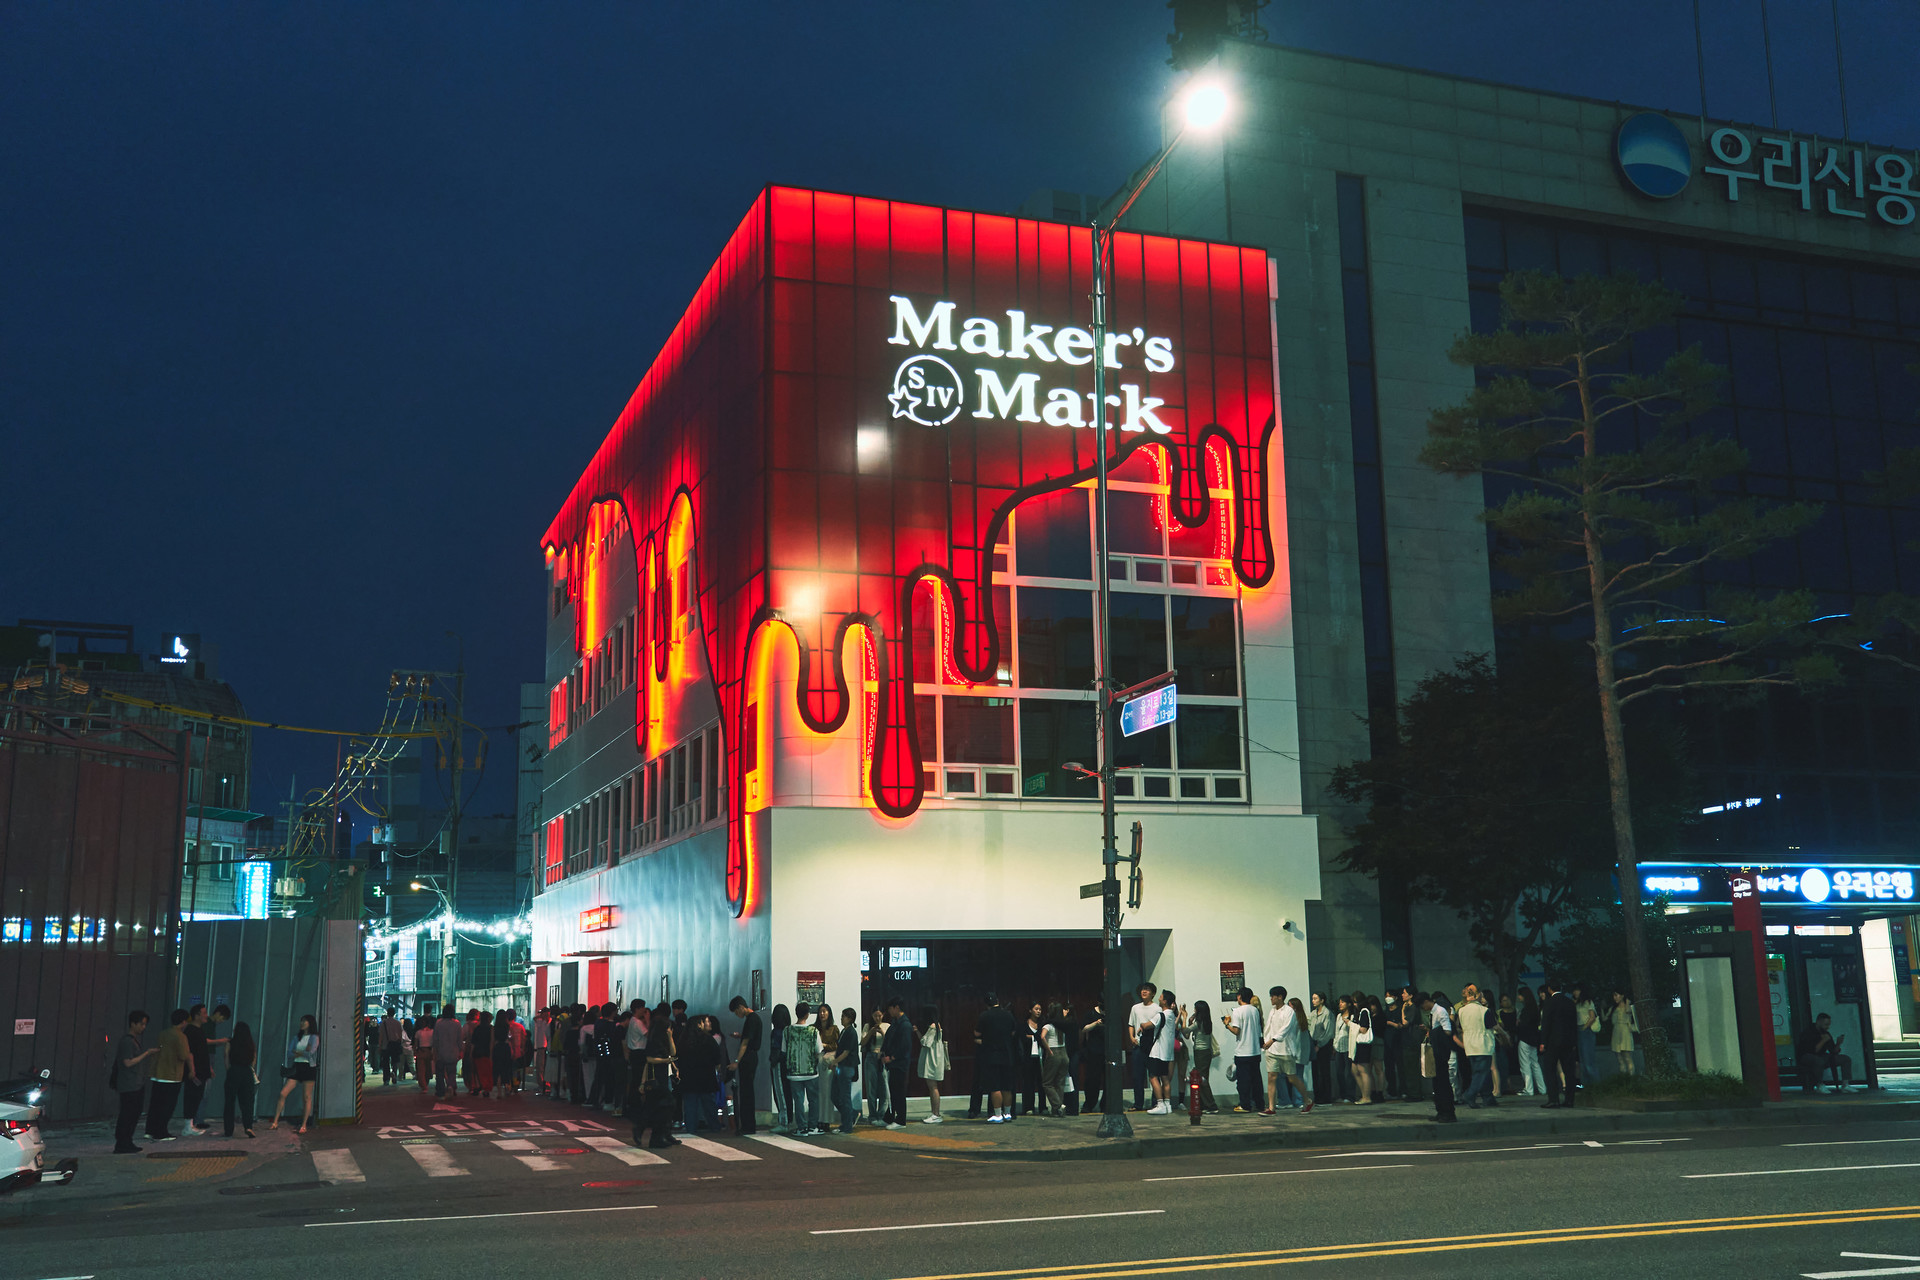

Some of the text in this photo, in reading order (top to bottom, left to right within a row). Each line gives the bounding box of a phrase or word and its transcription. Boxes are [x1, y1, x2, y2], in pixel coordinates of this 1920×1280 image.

[1705, 128, 1920, 225] 우리신용
[888, 295, 1174, 373] Maker's
[972, 368, 1172, 434] Mark
[1832, 871, 1913, 899] 우리은행
